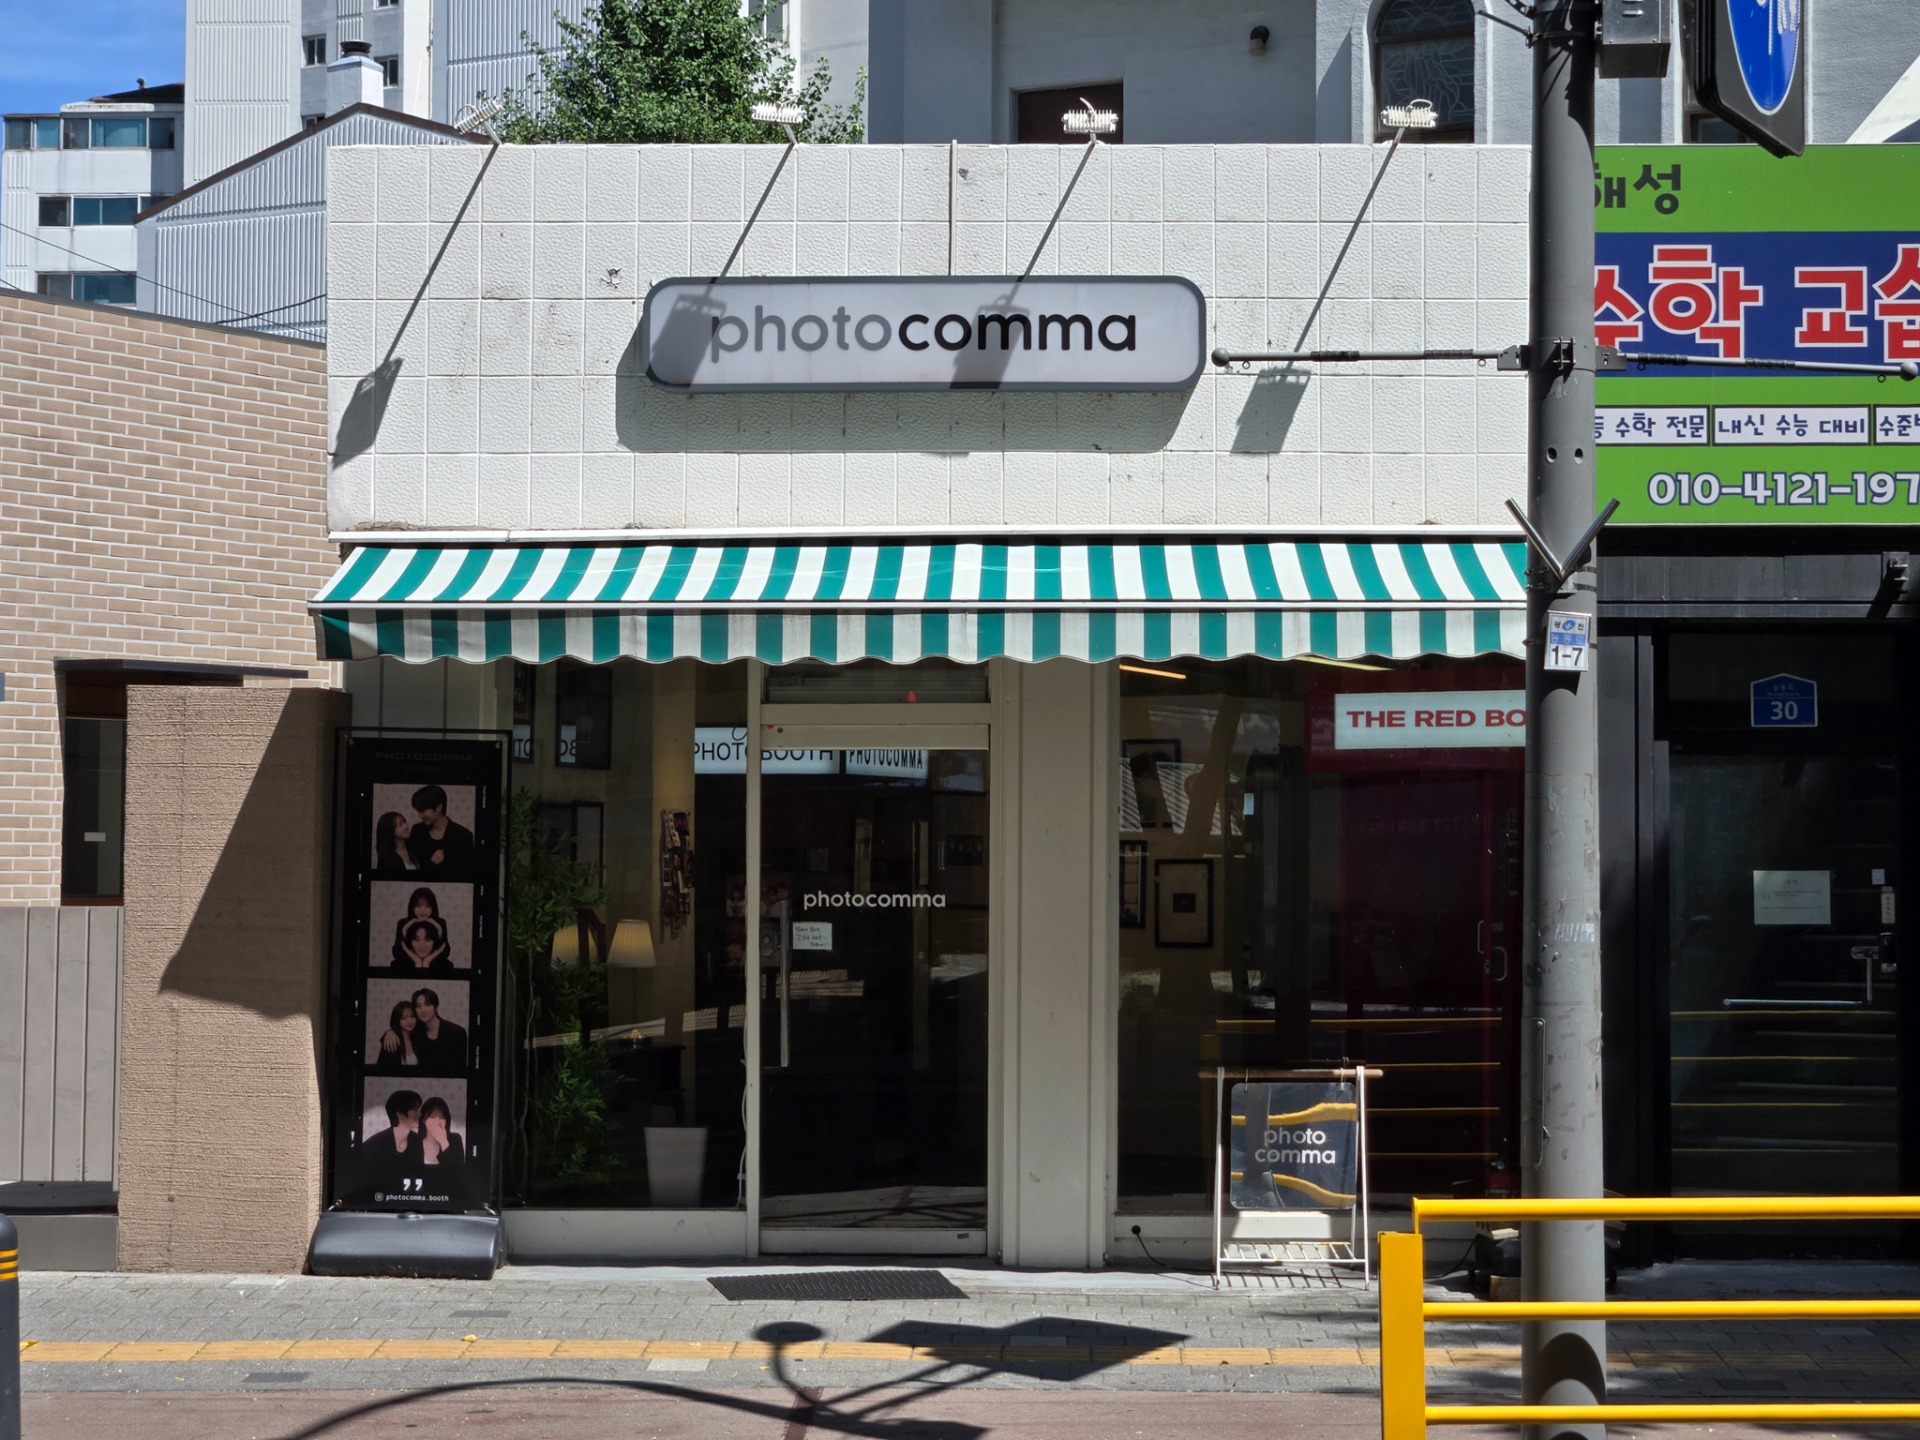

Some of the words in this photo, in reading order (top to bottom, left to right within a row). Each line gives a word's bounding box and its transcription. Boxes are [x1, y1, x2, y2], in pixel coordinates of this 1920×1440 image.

[1594, 244, 1764, 359] 수학
[711, 305, 1137, 363] photocomma
[1615, 413, 1656, 438] 수학
[1666, 415, 1705, 438] 전문
[1718, 414, 1765, 436] 내신
[1775, 414, 1809, 437] 수능
[1819, 418, 1865, 434] 대비
[1551, 645, 1583, 666] 1-7
[1346, 711, 1405, 727] THE
[1415, 710, 1476, 727] RED
[1770, 701, 1798, 720] 30
[375, 751, 475, 762] PHOTOCOMMA
[803, 890, 946, 911] photocomma
[1264, 1127, 1327, 1147] photo
[1254, 1149, 1336, 1165] comma
[385, 1193, 449, 1202] photocomma.booth
